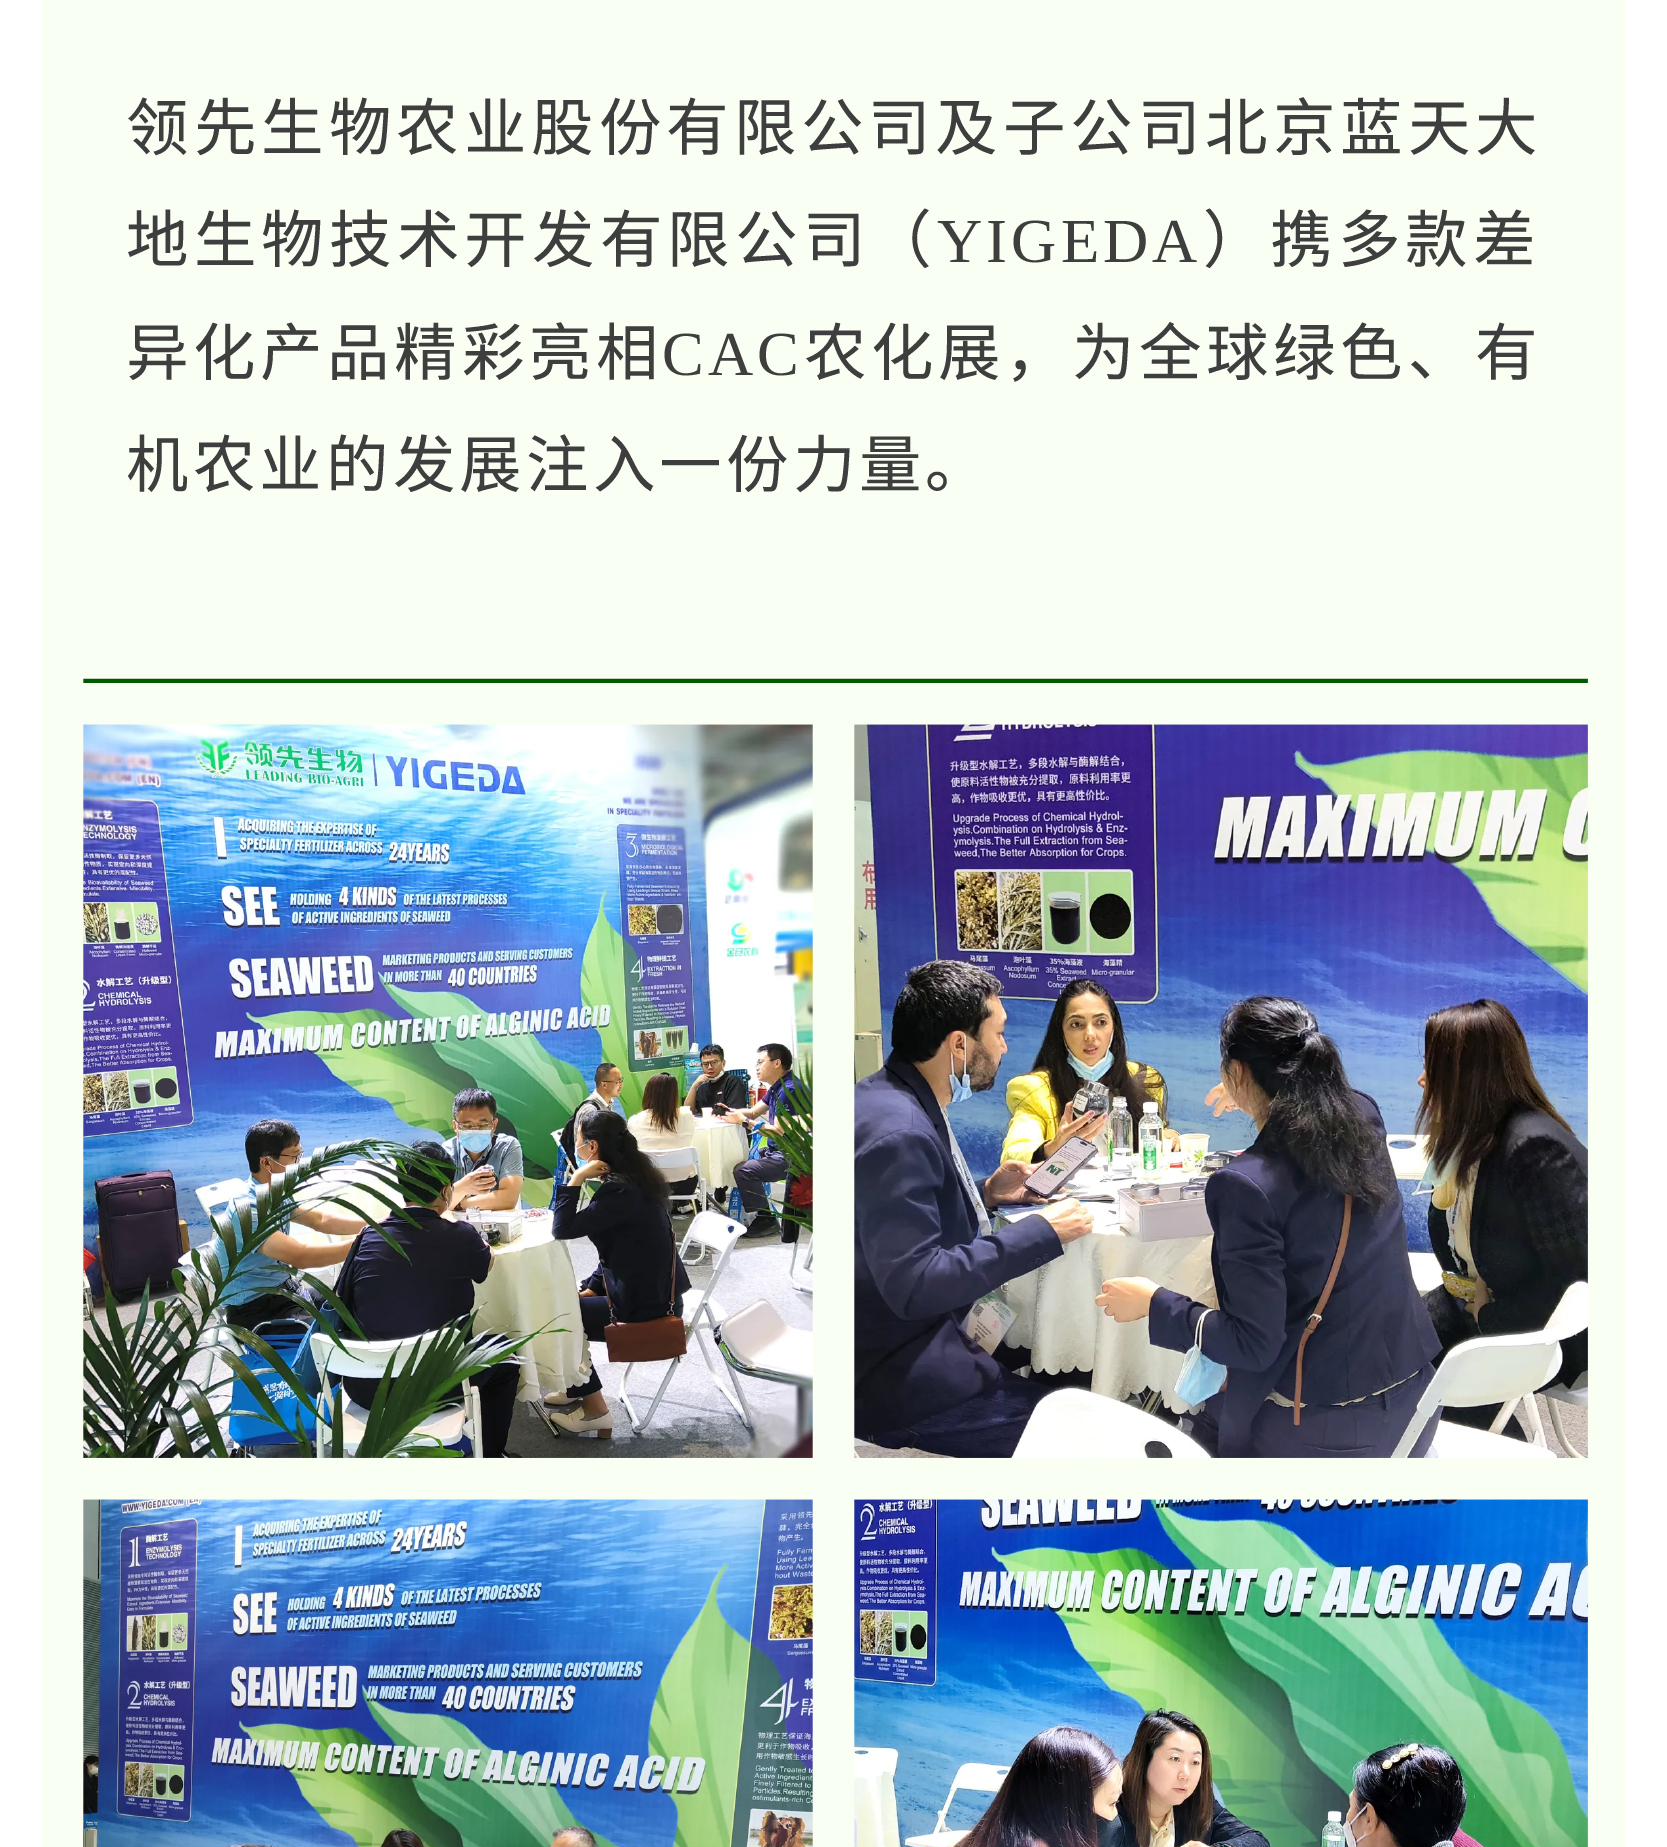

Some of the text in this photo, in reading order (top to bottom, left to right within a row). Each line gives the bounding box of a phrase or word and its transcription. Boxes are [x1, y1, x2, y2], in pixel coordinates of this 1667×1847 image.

[244, 742, 363, 773] 领先生物
[246, 769, 364, 787] LEADING BIO-AGRI
[386, 755, 526, 794] YIGEDA
[953, 811, 1123, 824] Upgrade Process of Chemical Hydrol-
[1214, 788, 1547, 861] MAXIMUM
[237, 818, 377, 837] ACQUIRING THE EXPERTISE OF
[953, 825, 1028, 837] ysis.Combination
[1046, 823, 1093, 836] Hydrolysis
[1096, 823, 1103, 833] &
[1106, 823, 1128, 833] Enz-
[239, 838, 450, 863] SPECIALTY FERTILIZER ACROSS 24YEARS
[953, 835, 1128, 848] ymolysis.The Full Extraction from Sea-
[1000, 848, 1027, 857] Better
[1029, 847, 1078, 859] Absorption
[1081, 847, 1093, 857] for
[1096, 847, 1127, 859] Crops.
[221, 885, 508, 927] SEE HOLDING 4 KINDS OF THE LATEST PROCESSES
[291, 910, 450, 924] OF ACTIVE INGREDIENTS OF SEAWEED
[382, 948, 573, 967] MARKETING PRODUCTS AND SERVING CUSTOMERS
[229, 955, 374, 1000] SEAWEED
[383, 965, 538, 988] IN MORE THAN 40 COUNTRIES
[1003, 965, 1040, 973] Ascophyllum
[1008, 972, 1037, 980] Nodosum
[1059, 967, 1087, 976] Seaweed
[1091, 969, 1135, 977] Micro-granular
[98, 991, 142, 1000] CHEMICAL
[98, 997, 152, 1007] HYDROLYSIS
[214, 1024, 344, 1060] MAXIMUM
[350, 1016, 452, 1049] CONTENT
[456, 1014, 482, 1040] OF
[484, 1008, 563, 1039] ALGINIC
[565, 1004, 611, 1030] ACID
[253, 1509, 382, 1537] ACQUIRING THE EXPERTISE OF
[879, 1517, 908, 1527] CHEMICAL
[879, 1525, 916, 1535] HYDROLYSIS
[252, 1521, 468, 1558] SPECIALTY FERTILIZER ACROSS 24YEARS
[146, 1550, 182, 1560] TECHNOLOGY
[959, 1570, 1095, 1611] MAXIMUM
[1101, 1568, 1258, 1615] CONTENT
[1263, 1566, 1317, 1617] OF
[1319, 1562, 1522, 1619] ALGINIC
[233, 1582, 542, 1635] SEE HOLDING 4 KINDS OF THE LATEST PROCESSES
[286, 1609, 457, 1631] OF ACTIVE INGREDIENTS OF SEAWEED
[368, 1661, 643, 1680] MARKETING PRODUCTS AND SERVING CUSTOMERS
[230, 1665, 358, 1709] SEAWEED
[367, 1685, 576, 1711] IN MORE THAN 40 COUNTRIES
[211, 1738, 320, 1770] MAXIMUM
[324, 1742, 440, 1778] CONTENT
[443, 1747, 480, 1781] OF
[482, 1750, 610, 1788] ALGINIC
[613, 1754, 706, 1794] ACID
